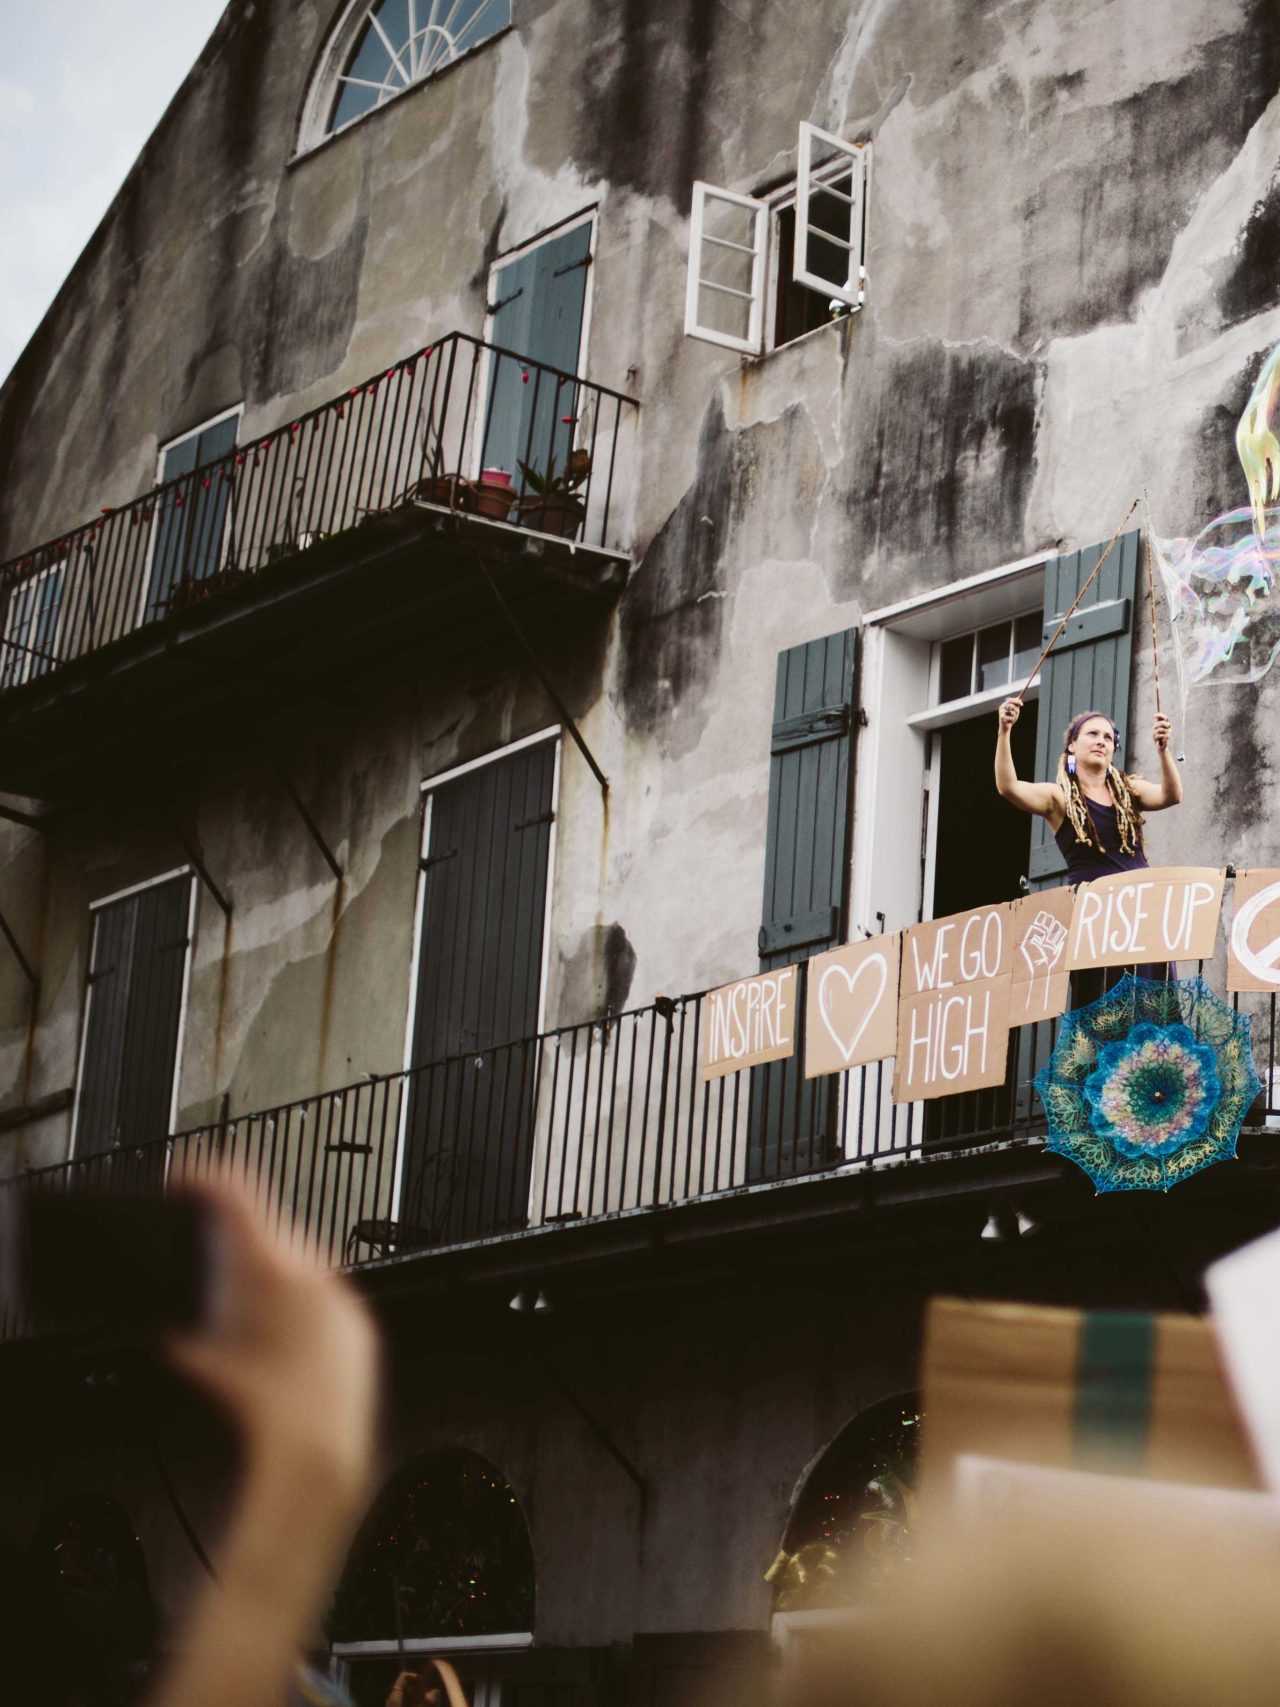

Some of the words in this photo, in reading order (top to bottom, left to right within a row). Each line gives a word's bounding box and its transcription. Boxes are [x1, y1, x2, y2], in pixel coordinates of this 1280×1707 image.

[911, 923, 956, 993] WE
[959, 911, 1003, 981] GO
[1162, 882, 1216, 951] UP
